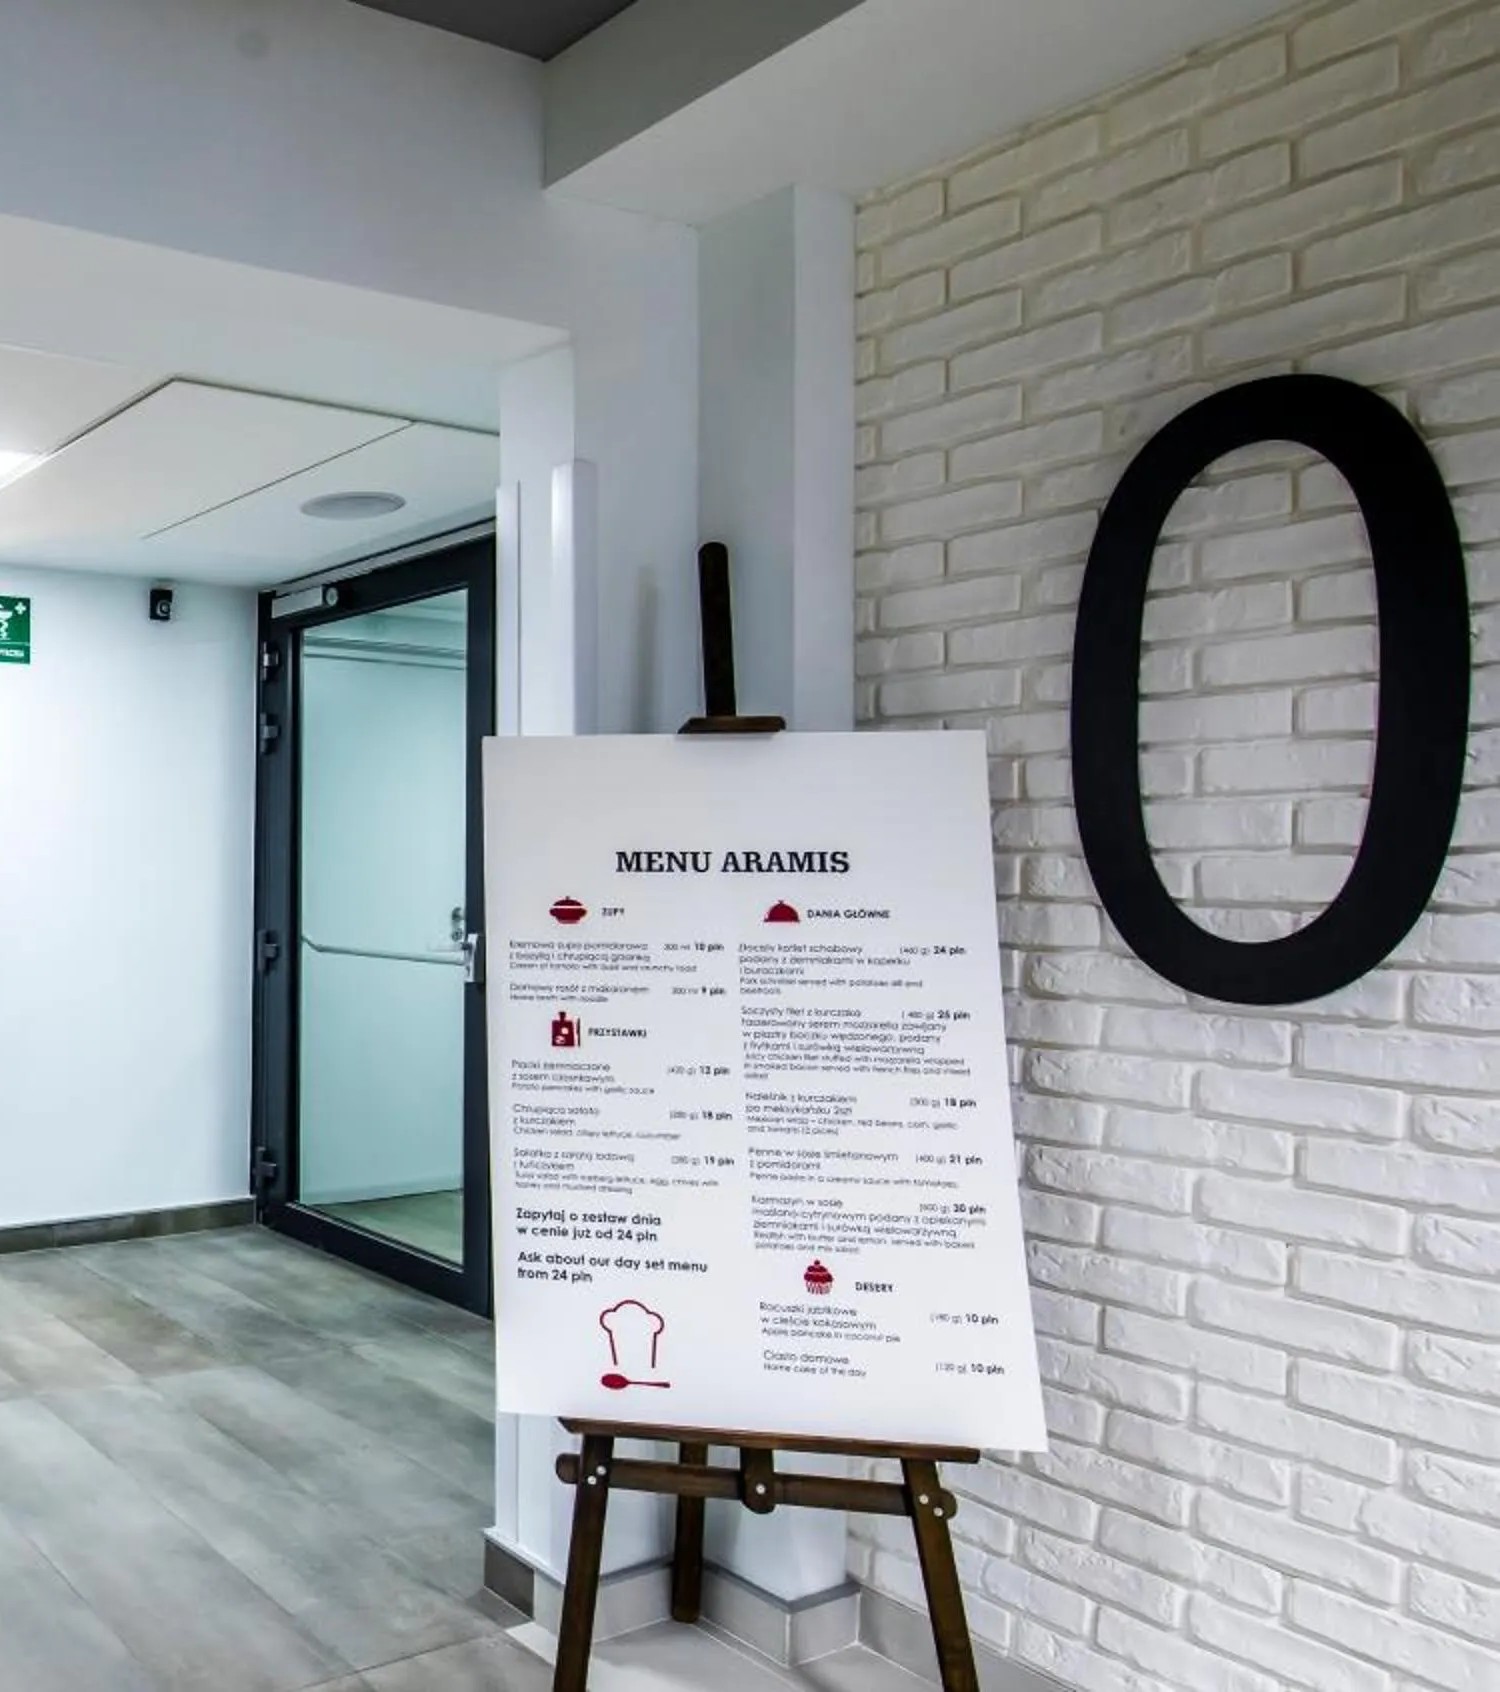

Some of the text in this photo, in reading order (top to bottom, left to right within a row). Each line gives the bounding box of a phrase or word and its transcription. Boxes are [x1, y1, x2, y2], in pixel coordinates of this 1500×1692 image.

[616, 851, 850, 873] MENU ARAMIS
[807, 909, 890, 919] DANIA GŁÓWNE
[695, 943, 706, 951] 10
[707, 944, 724, 952] pln
[809, 944, 863, 954] schabowy
[934, 946, 966, 956] 24 pln
[709, 987, 726, 996] pln
[953, 1012, 970, 1021] pln
[588, 1028, 647, 1037] PRZYSTAWKI
[714, 1067, 730, 1076] pln
[959, 1099, 976, 1109] pln
[716, 1112, 732, 1120] pln
[718, 1158, 734, 1167] pln
[965, 1155, 983, 1165] pln
[968, 1205, 986, 1215] pln
[516, 1208, 661, 1226] Zapytaj o zestaw dnia
[531, 1227, 569, 1237] cenie
[572, 1228, 592, 1240] już
[595, 1229, 613, 1240] od
[617, 1230, 633, 1240] 24
[636, 1231, 657, 1243] pln
[518, 1252, 708, 1272] Ask about our day set menu
[518, 1268, 592, 1284] from 24 pln
[855, 1282, 893, 1292] DESERY
[965, 1314, 998, 1325] 10 pln
[971, 1363, 1004, 1375] 10 pln
